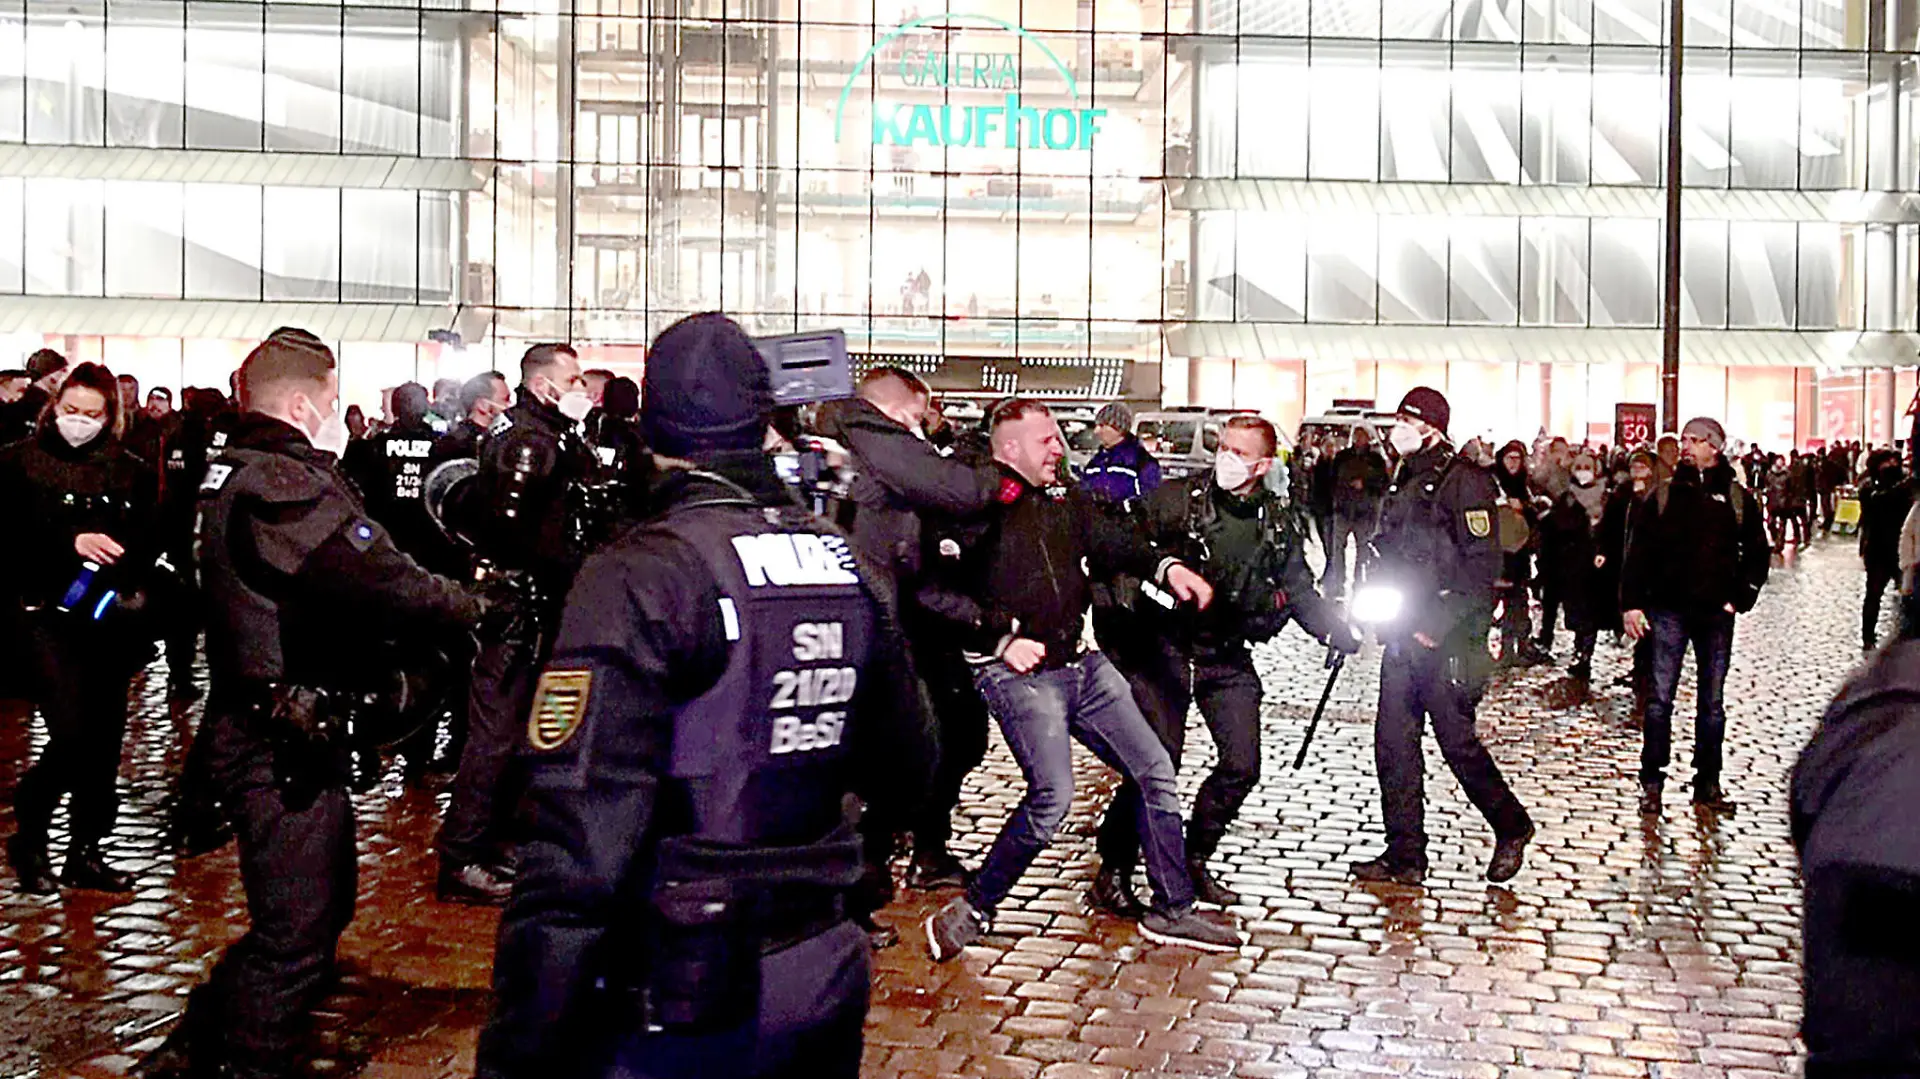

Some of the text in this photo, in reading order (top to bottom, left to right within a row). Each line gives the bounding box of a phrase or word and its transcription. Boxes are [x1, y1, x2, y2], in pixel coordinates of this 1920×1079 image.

[901, 49, 1019, 88] GALERIA
[792, 622, 843, 661] SN
[769, 667, 857, 709] 21/20
[769, 711, 847, 754] BeSi
